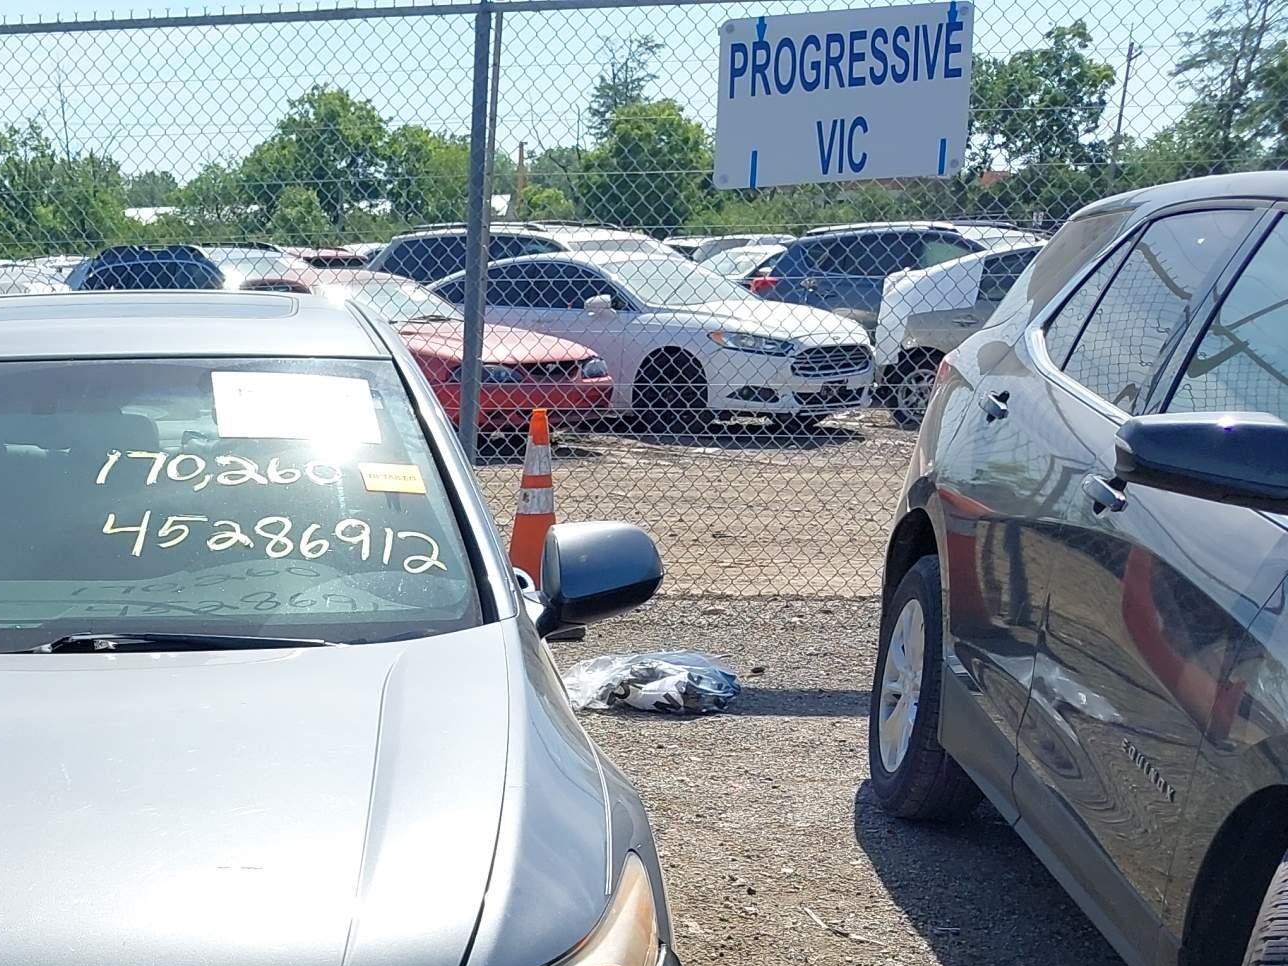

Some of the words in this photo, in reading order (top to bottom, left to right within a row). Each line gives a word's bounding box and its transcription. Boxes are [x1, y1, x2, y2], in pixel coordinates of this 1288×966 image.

[729, 21, 964, 99] PROGRESSIVE
[816, 115, 869, 176] VIC
[95, 448, 342, 492] 170,260
[102, 510, 448, 574] 45286912
[1121, 737, 1176, 803] EQUINOX
